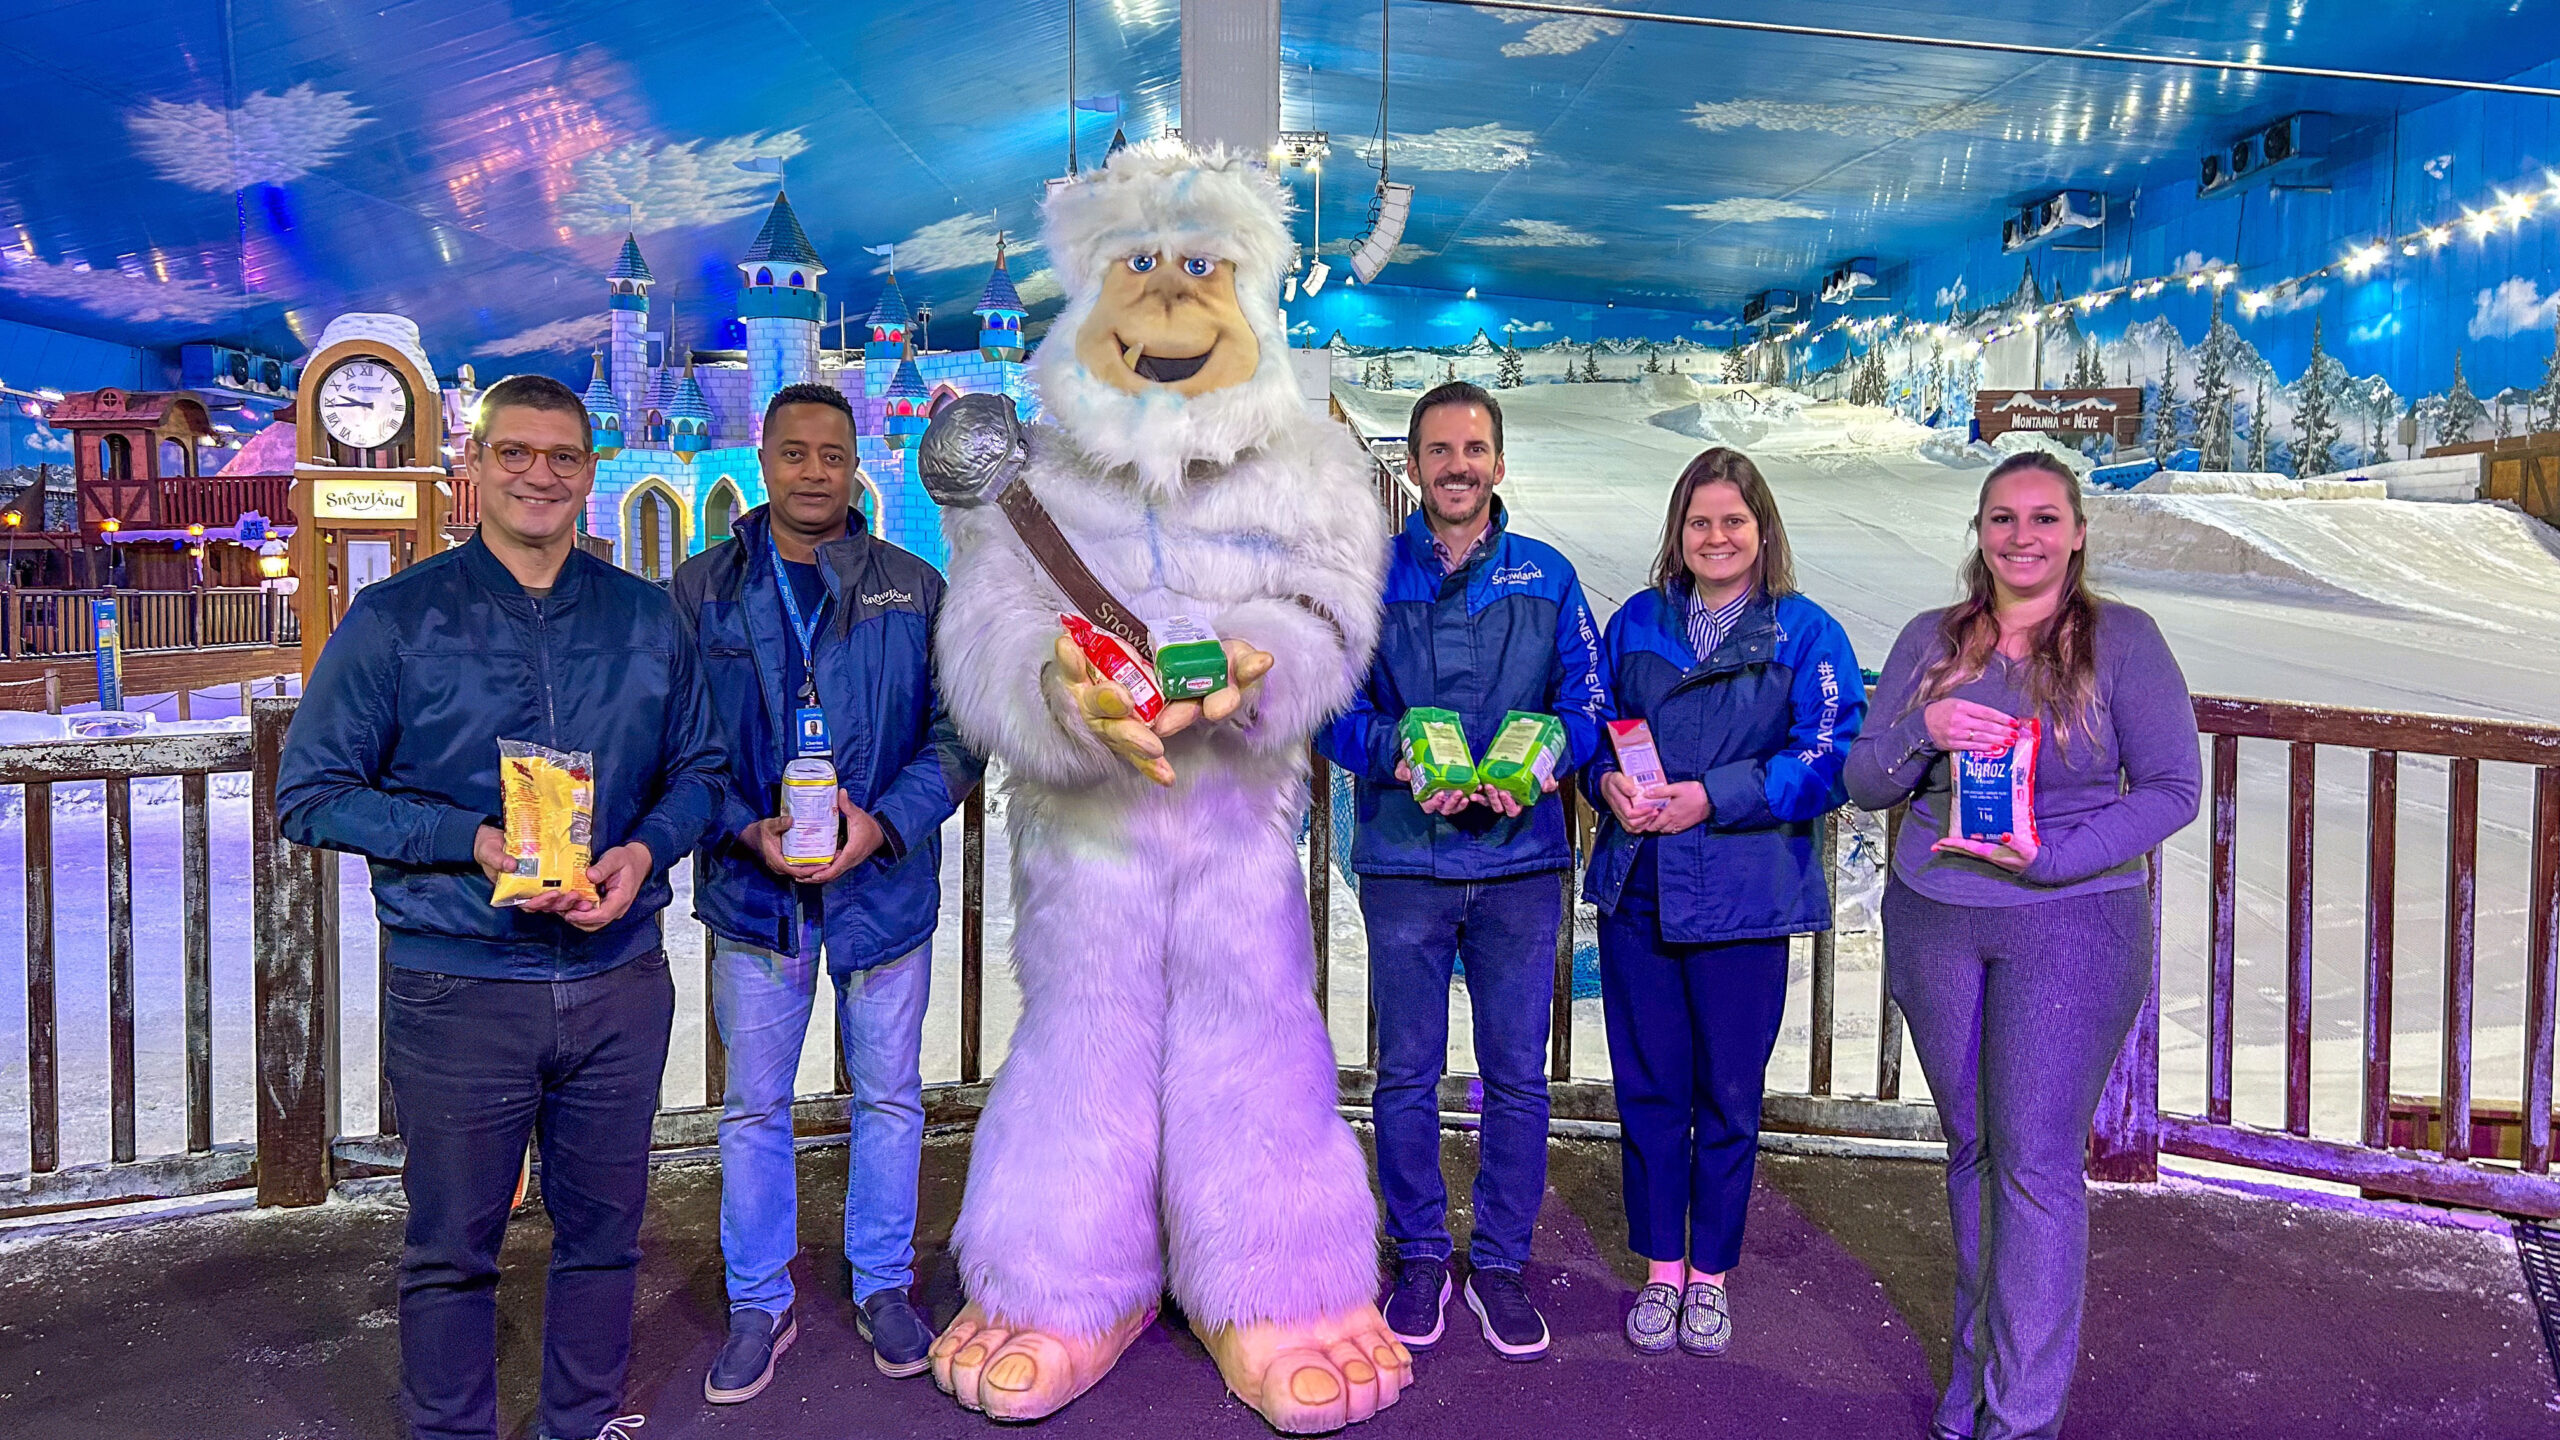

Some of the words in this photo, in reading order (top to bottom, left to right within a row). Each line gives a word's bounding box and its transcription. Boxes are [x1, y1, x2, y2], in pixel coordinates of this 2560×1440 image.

[360, 365, 373, 376] XII
[2011, 413, 2059, 429] MONTANHA
[2073, 412, 2099, 428] NEVE
[243, 521, 264, 530] ICE
[1492, 569, 1542, 585] Snowland
[1965, 763, 2005, 778] ARROZ
